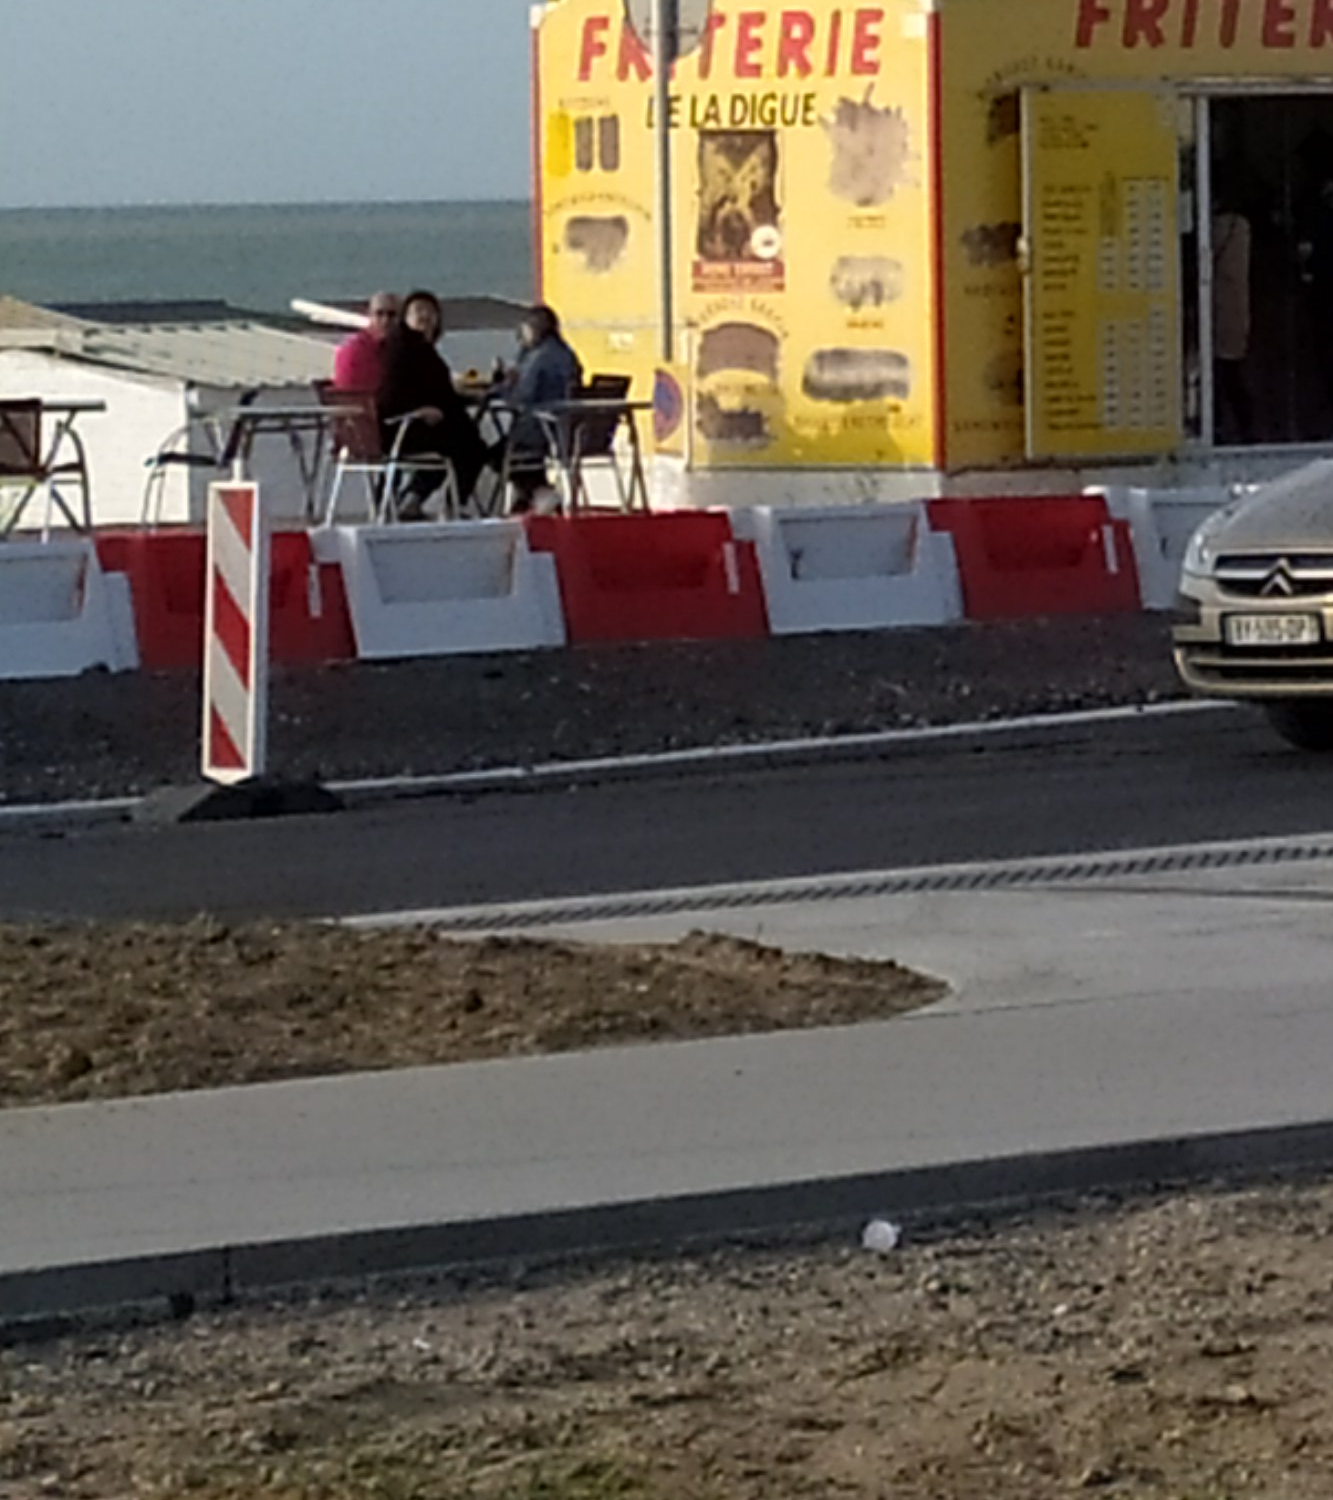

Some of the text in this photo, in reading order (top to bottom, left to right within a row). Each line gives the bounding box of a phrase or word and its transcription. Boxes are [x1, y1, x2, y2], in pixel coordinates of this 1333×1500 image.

[578, 9, 885, 81] FRTERIE
[690, 93, 722, 128] LA
[730, 92, 817, 127] DIGUE
